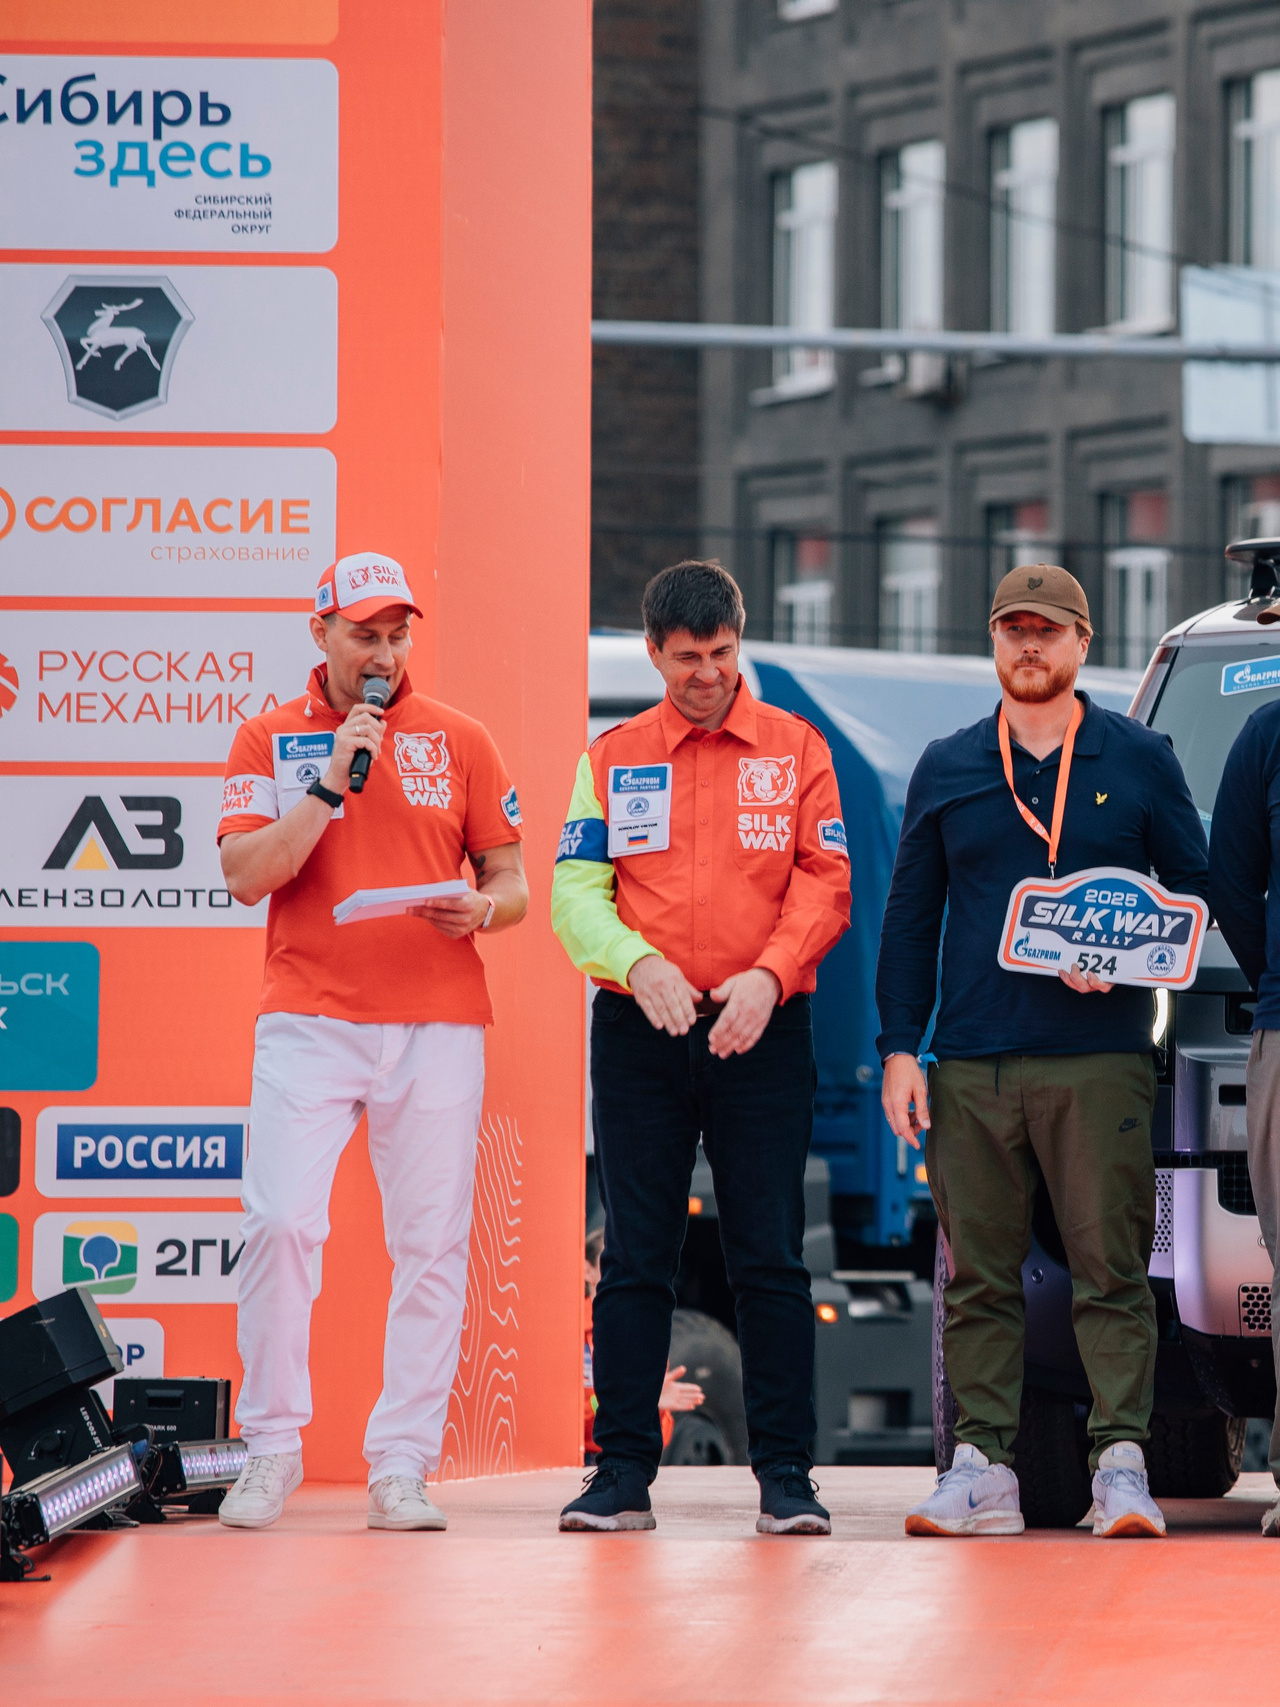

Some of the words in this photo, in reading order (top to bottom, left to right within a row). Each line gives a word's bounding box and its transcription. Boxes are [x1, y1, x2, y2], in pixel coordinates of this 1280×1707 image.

[0, 73, 232, 141] ибирь
[74, 139, 272, 188] здесь
[194, 193, 272, 206] СИБИРСКИЙ
[174, 207, 272, 221] ФЕДЕРАЛЬНЫЙ
[231, 224, 272, 235] ОКРУГ
[24, 496, 311, 535] СОГЛАСИЕ
[150, 543, 311, 564] страхование
[38, 650, 255, 683] РУССКАЯ
[1233, 682, 1260, 690] GENERAL
[401, 776, 452, 795] SILK
[404, 791, 452, 810] WAY
[738, 813, 791, 833] SILK
[738, 831, 791, 852] WAY
[1084, 888, 1138, 908] 2025
[1028, 901, 1111, 931] SILK
[1113, 911, 1185, 938] WAY
[1072, 931, 1133, 947] RALLY
[1027, 947, 1061, 962] GAZPROM
[1077, 952, 1117, 975] 524
[73, 1135, 227, 1169] РОССИЯ
[80, 1406, 90, 1421] LED
